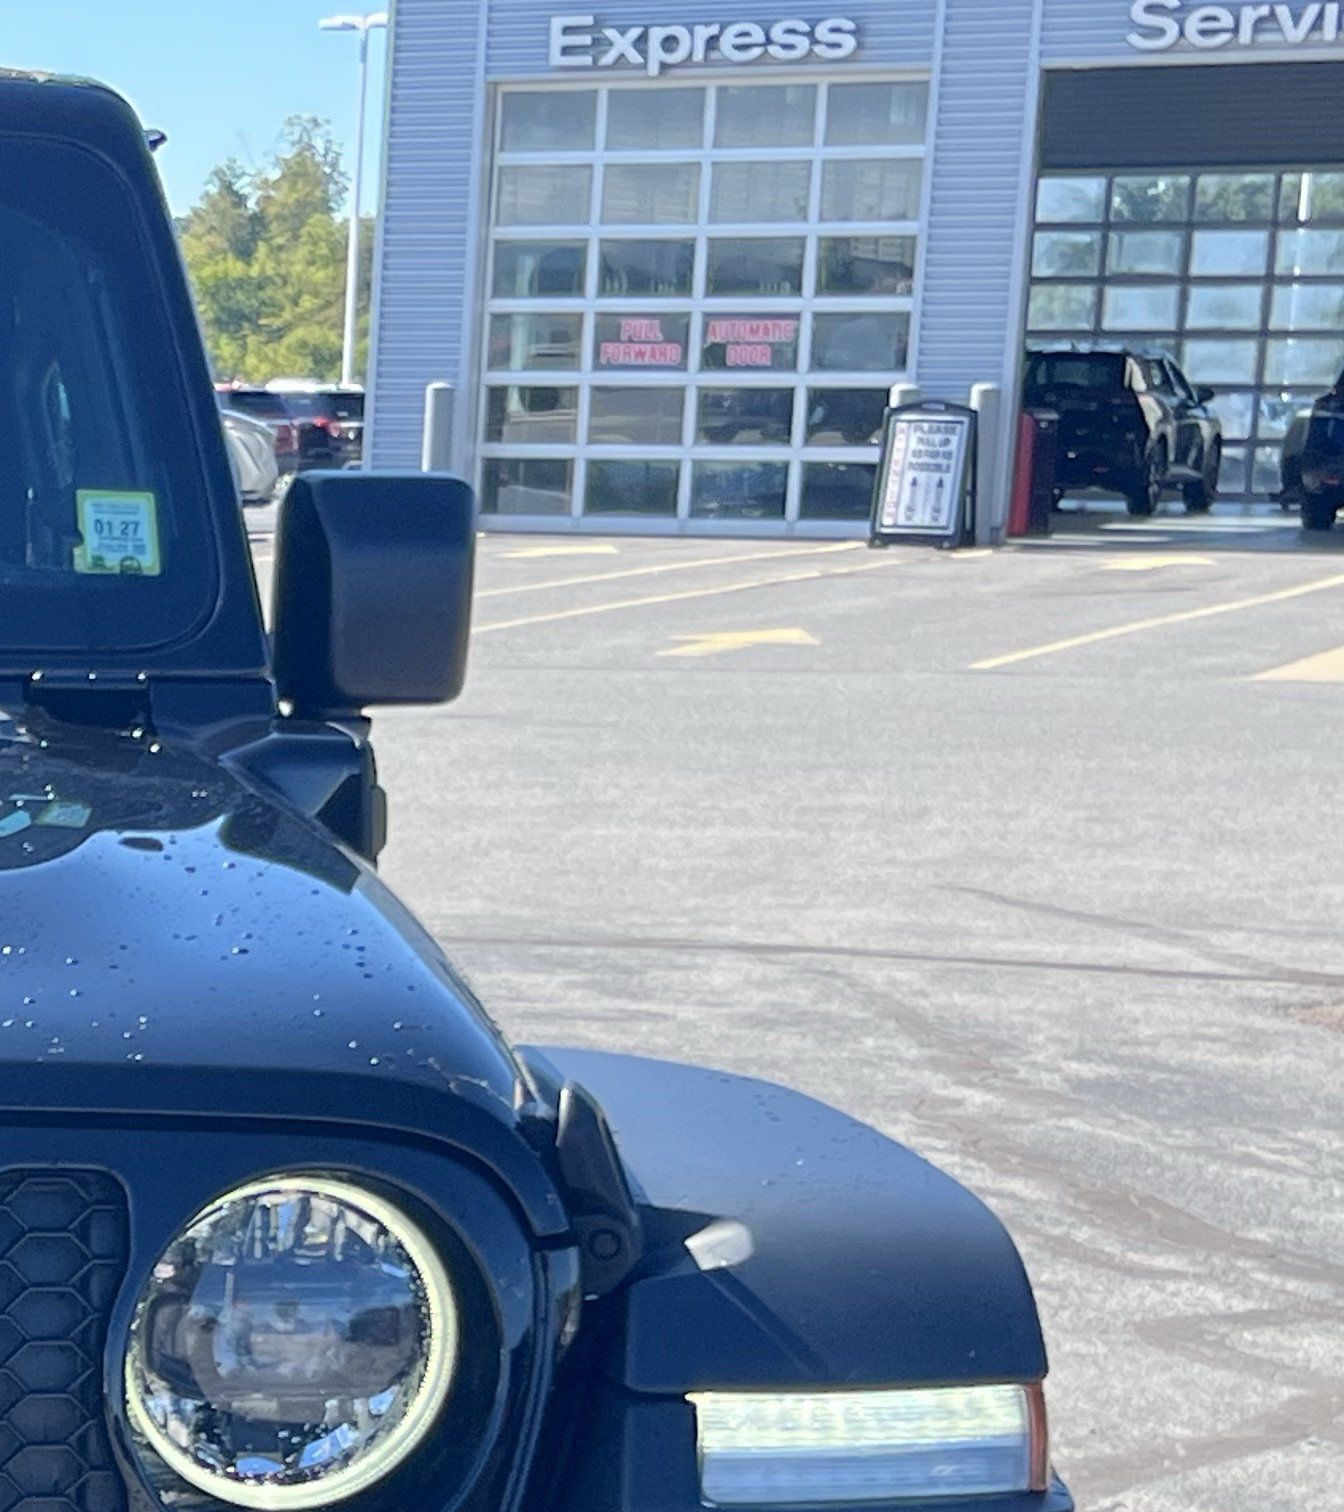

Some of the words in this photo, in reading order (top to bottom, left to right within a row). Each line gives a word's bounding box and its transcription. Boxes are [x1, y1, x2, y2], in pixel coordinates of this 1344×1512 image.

[548, 14, 858, 77] Express
[620, 319, 663, 341] PULL
[706, 319, 798, 343] AUTOMATIC
[600, 342, 682, 364] FORWARD
[725, 343, 772, 366] DOOR
[119, 520, 140, 536] 27
